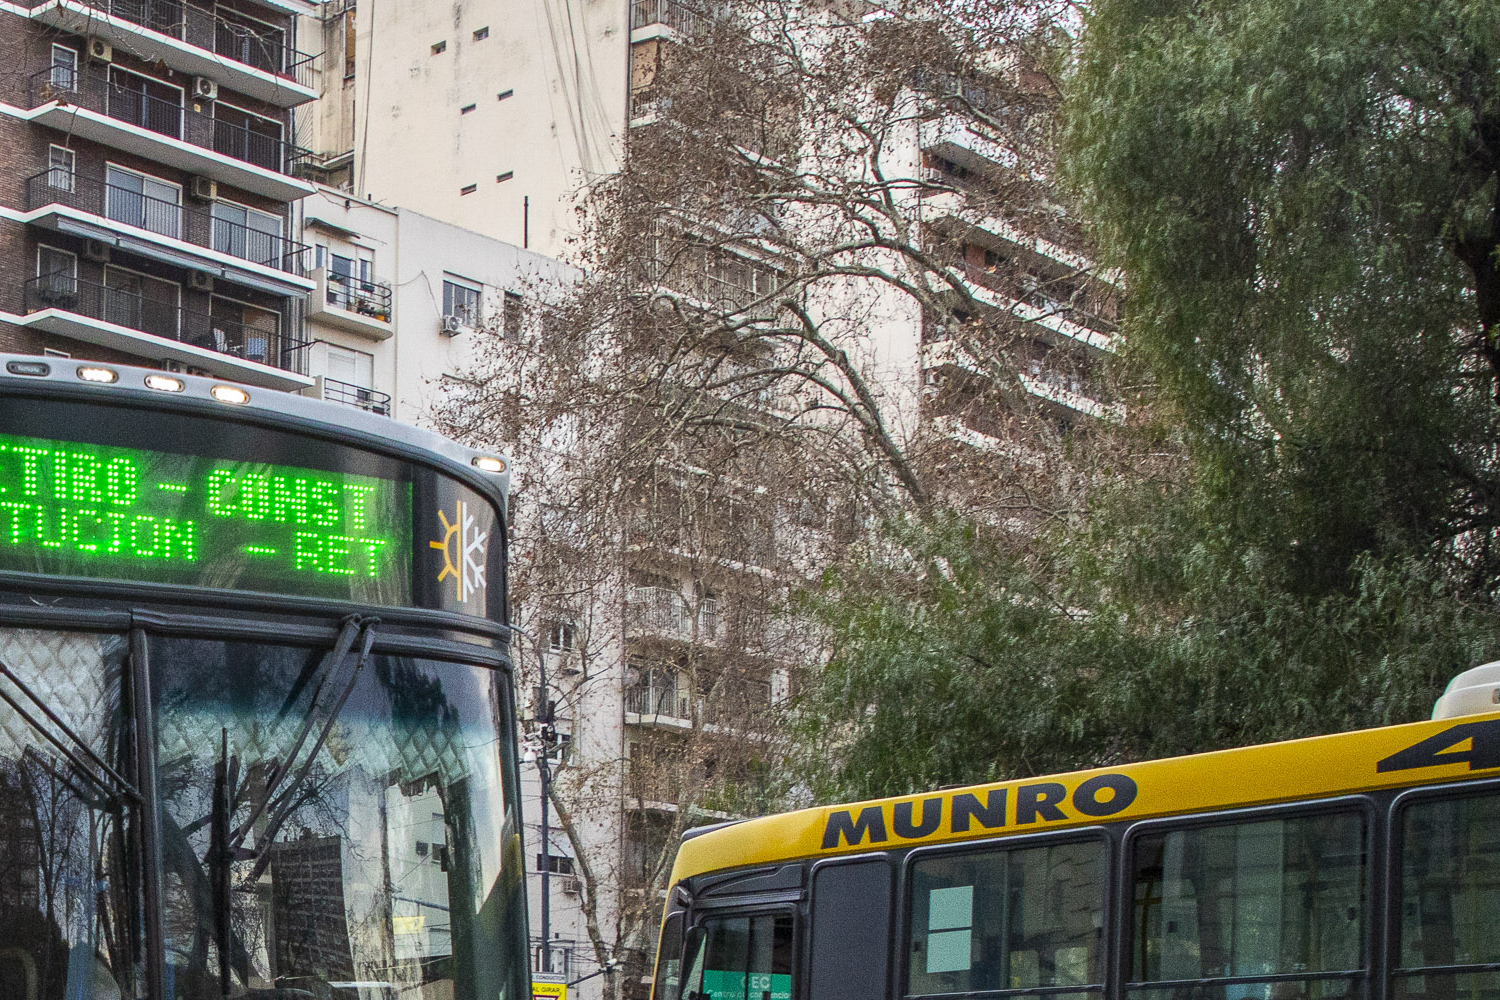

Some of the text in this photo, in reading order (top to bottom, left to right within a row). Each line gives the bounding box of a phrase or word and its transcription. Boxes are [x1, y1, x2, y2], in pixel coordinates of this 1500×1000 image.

[206, 469, 376, 531] CONST
[296, 531, 387, 578] RET
[820, 773, 1139, 850] MUNRO
